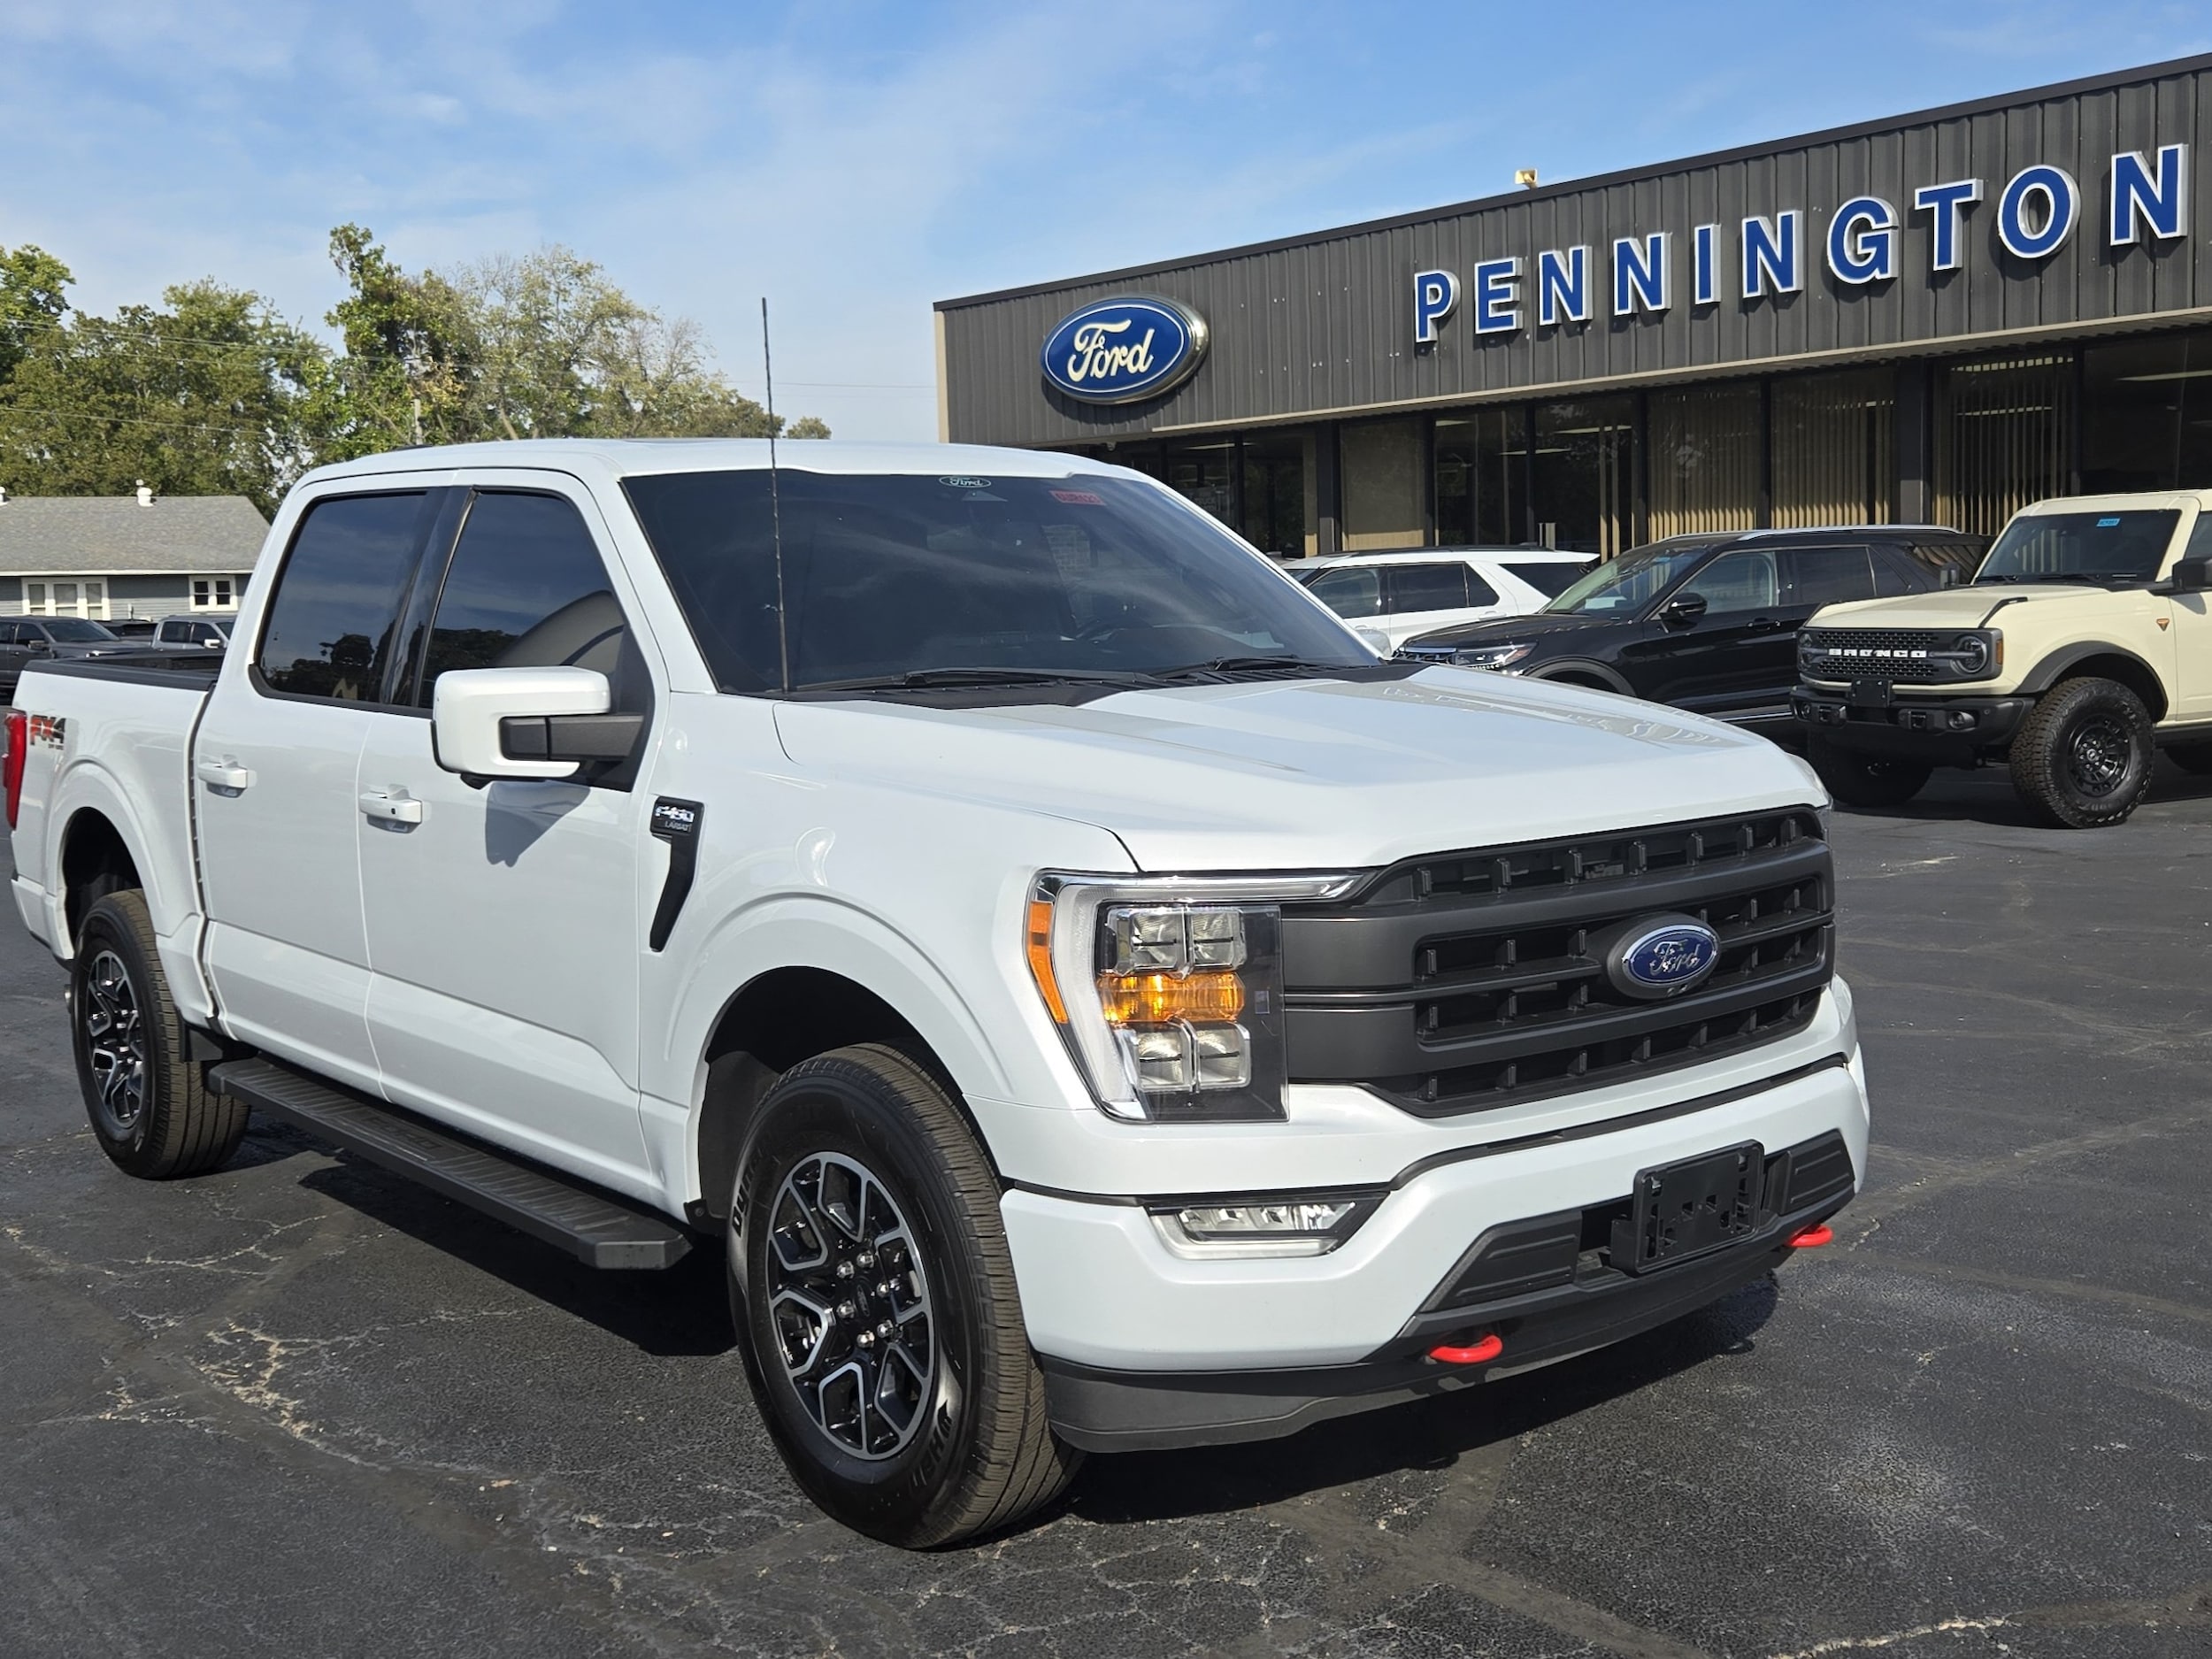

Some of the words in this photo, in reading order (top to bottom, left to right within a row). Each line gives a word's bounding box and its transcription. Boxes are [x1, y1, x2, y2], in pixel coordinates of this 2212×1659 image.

[1414, 143, 2187, 342] PENNINGTON
[1067, 319, 1155, 382] Ford
[949, 477, 983, 487] Ford
[1828, 648, 1927, 658] BRONCO
[30, 714, 65, 746] FX4
[1649, 938, 1701, 976] Ford
